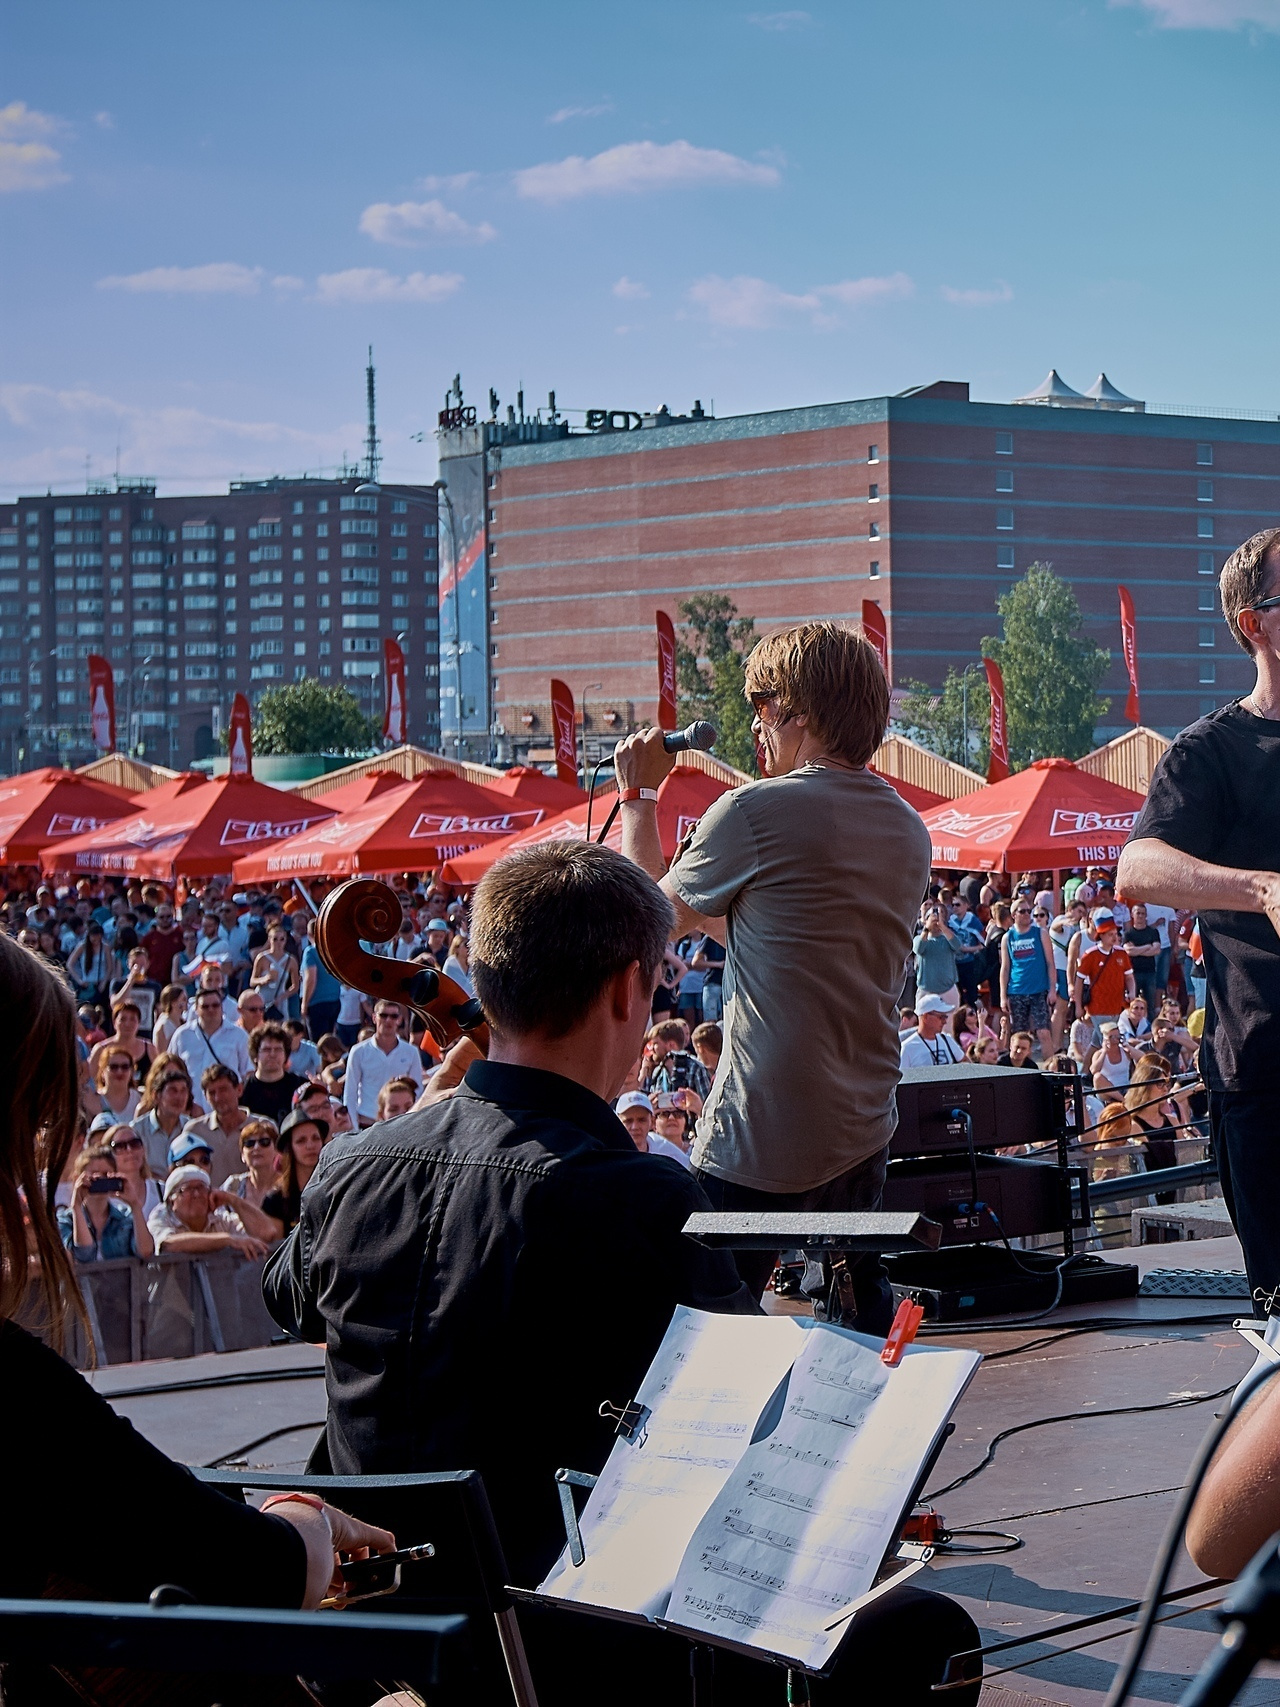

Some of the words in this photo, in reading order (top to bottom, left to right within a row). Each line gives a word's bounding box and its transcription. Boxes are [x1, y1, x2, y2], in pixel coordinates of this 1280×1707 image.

[662, 651, 673, 695] Bud
[559, 717, 573, 759] Bud
[231, 819, 309, 840] Bud
[424, 815, 513, 833] Bud
[1059, 811, 1141, 830] Bud
[932, 846, 942, 861] OR
[943, 846, 959, 862] YOU
[1076, 846, 1106, 861] THIS
